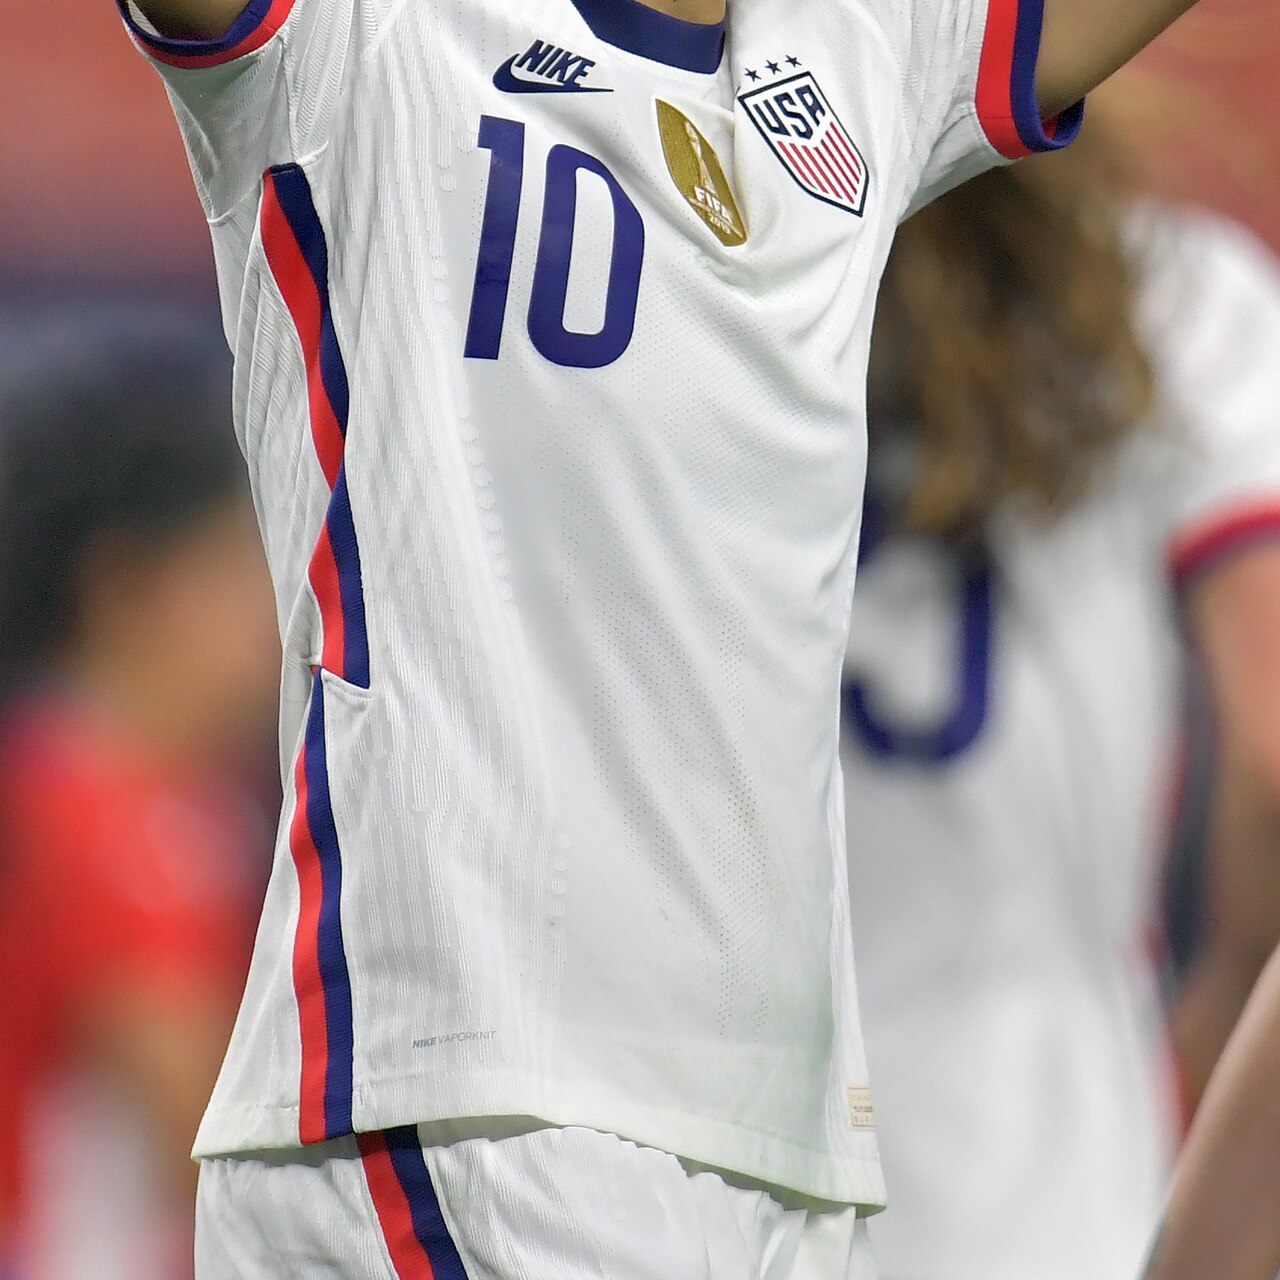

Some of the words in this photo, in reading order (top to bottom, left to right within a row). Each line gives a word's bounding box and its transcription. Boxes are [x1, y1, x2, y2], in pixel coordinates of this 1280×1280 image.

[515, 39, 596, 87] NIKE
[752, 84, 826, 140] USA
[693, 186, 733, 224] FIFA
[463, 114, 645, 369] 10
[412, 1036, 437, 1048] NIKE
[438, 1030, 497, 1044] VAPORKNIT
